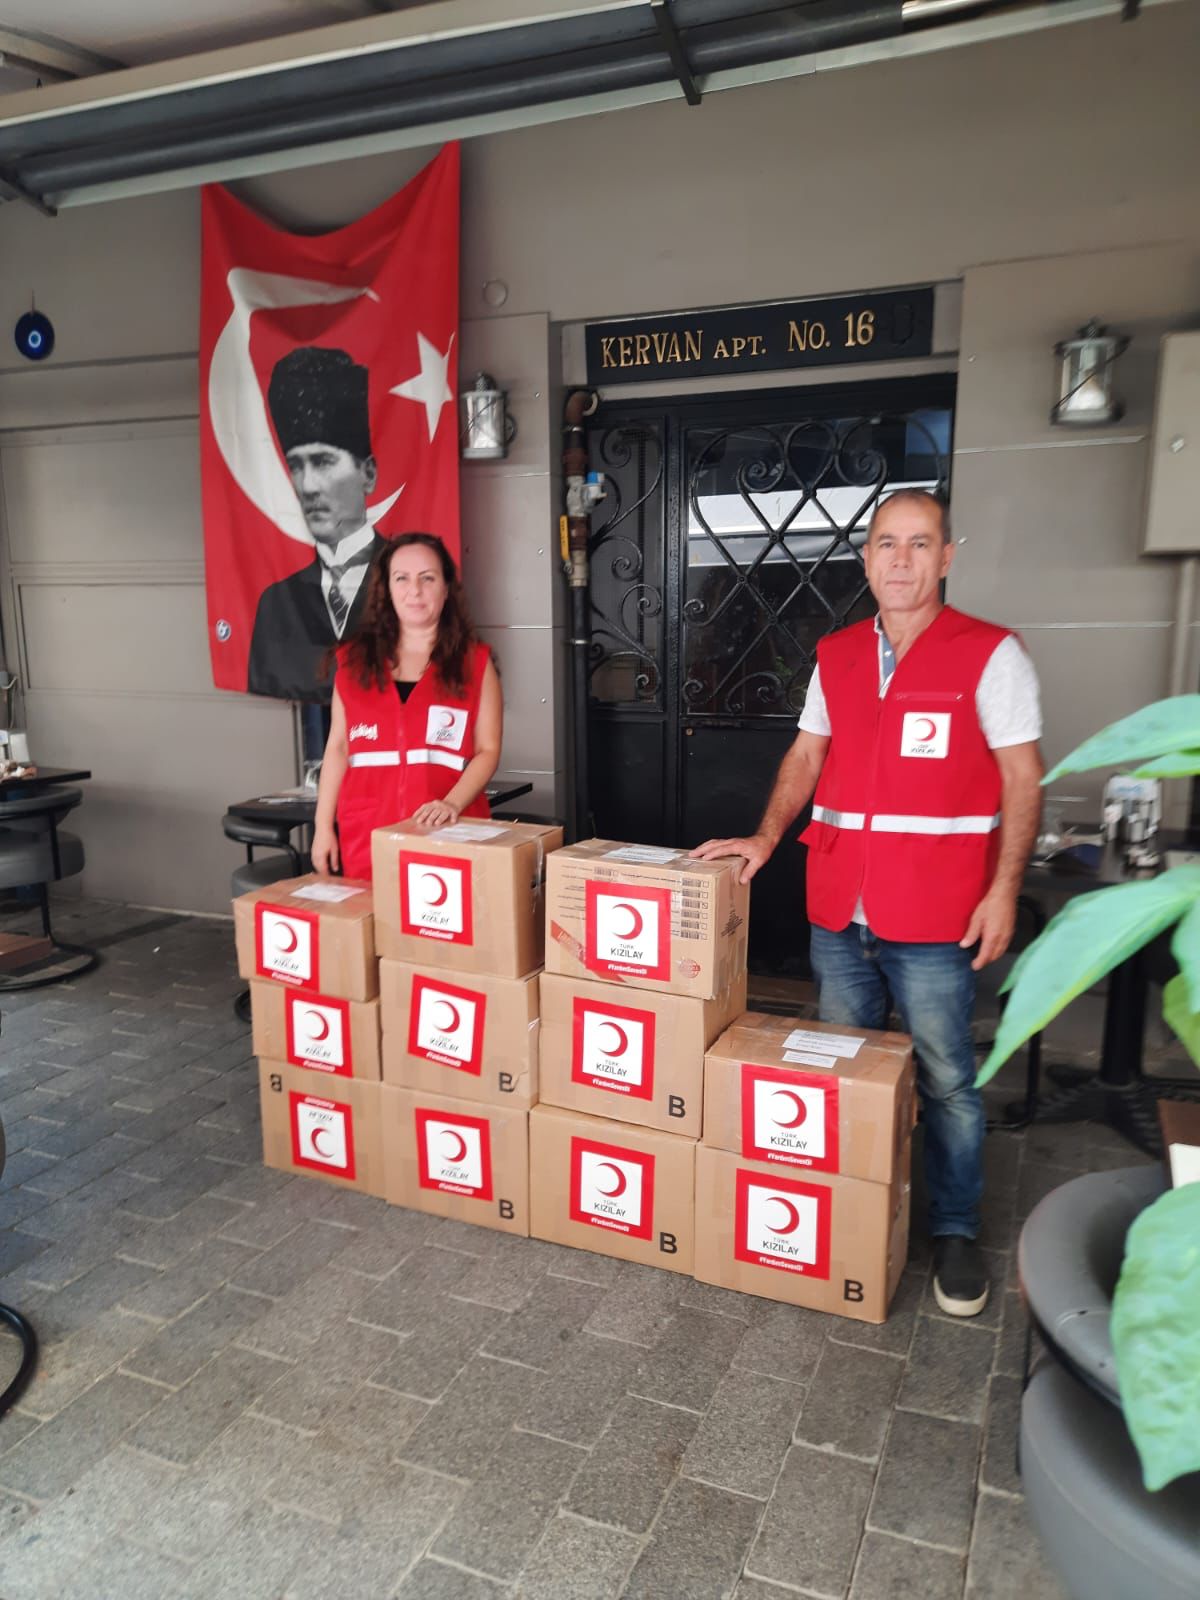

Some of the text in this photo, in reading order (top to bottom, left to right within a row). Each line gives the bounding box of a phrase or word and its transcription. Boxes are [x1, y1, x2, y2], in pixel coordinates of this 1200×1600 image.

[601, 329, 704, 368] KERVAN
[713, 335, 767, 360] APT.
[844, 309, 876, 348] 16
[610, 947, 644, 959] KIZILAY
[596, 1063, 628, 1077] KIZILAY
[499, 1072, 515, 1093] B
[668, 1094, 686, 1118] B
[770, 1136, 808, 1150] KIZILAY
[499, 1198, 514, 1219] B
[594, 1202, 627, 1217] KIZILAY
[659, 1231, 678, 1254] B
[762, 1240, 799, 1255] KIZILAY
[844, 1279, 864, 1303] B
